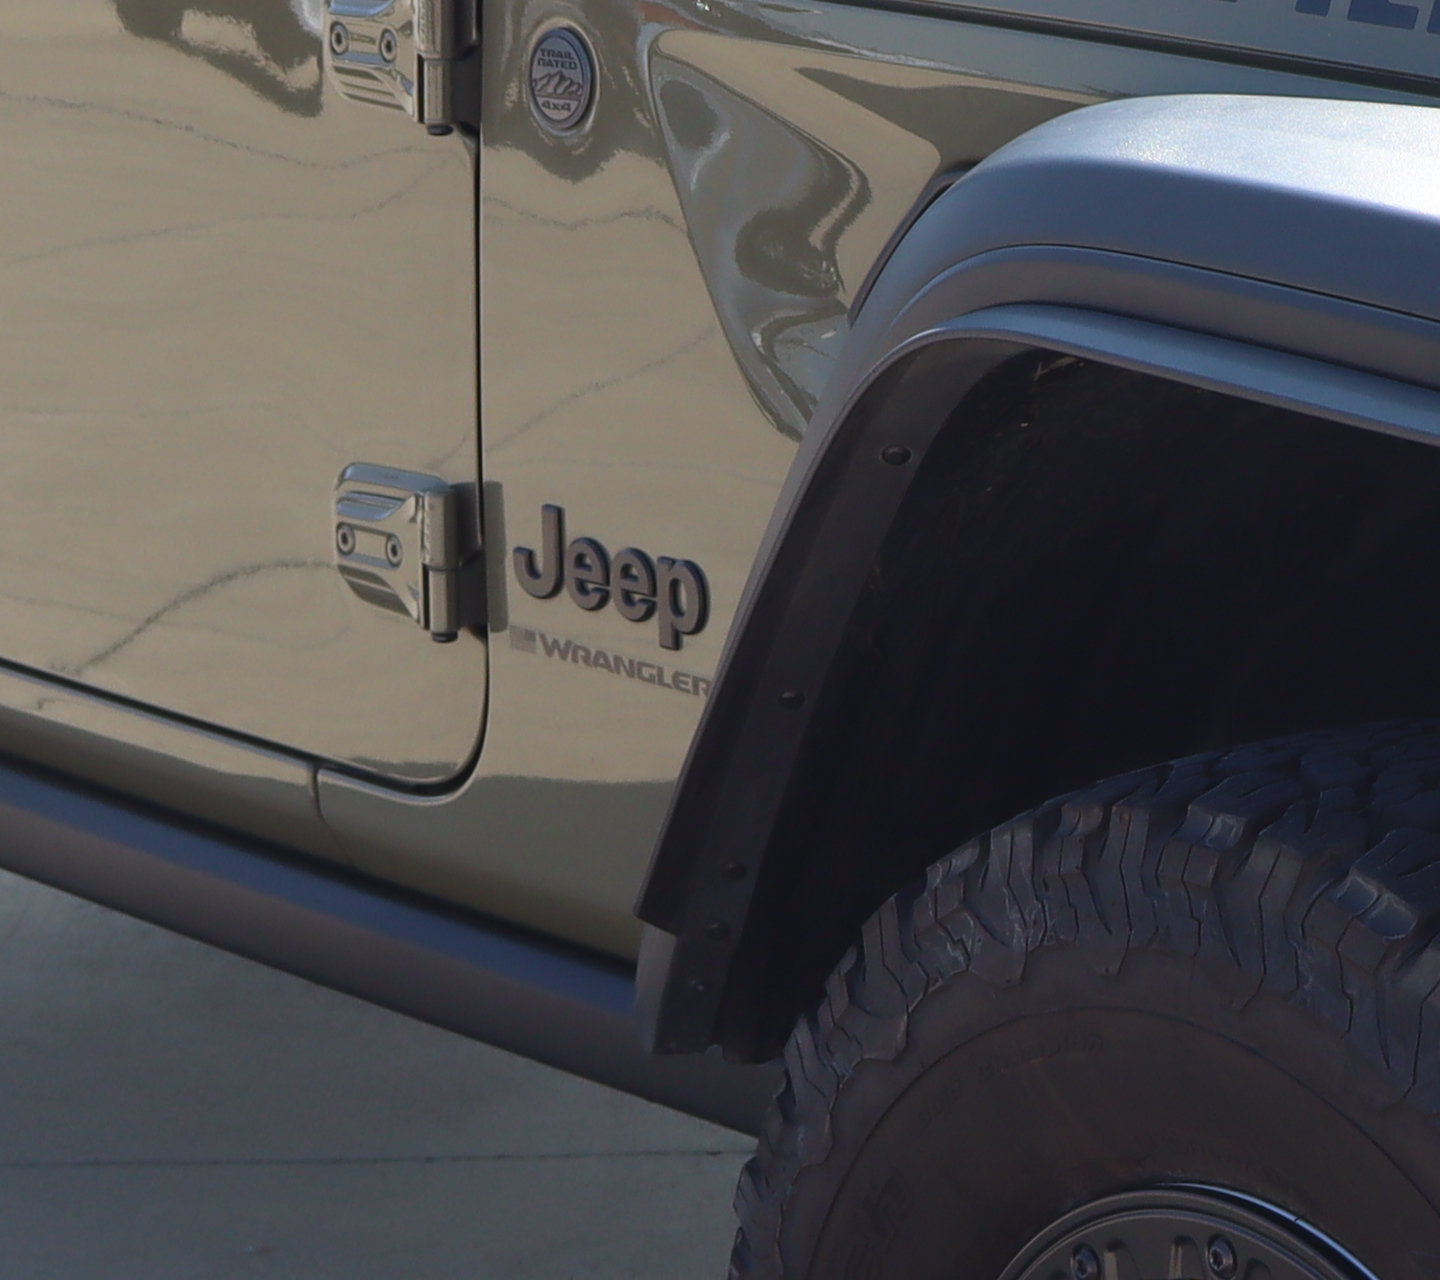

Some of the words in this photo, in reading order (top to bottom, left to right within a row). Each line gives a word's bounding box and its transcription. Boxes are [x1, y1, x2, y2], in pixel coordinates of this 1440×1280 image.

[540, 48, 574, 60] TRAIL
[513, 504, 710, 651] Jeep
[538, 633, 713, 697] WRANGLER
